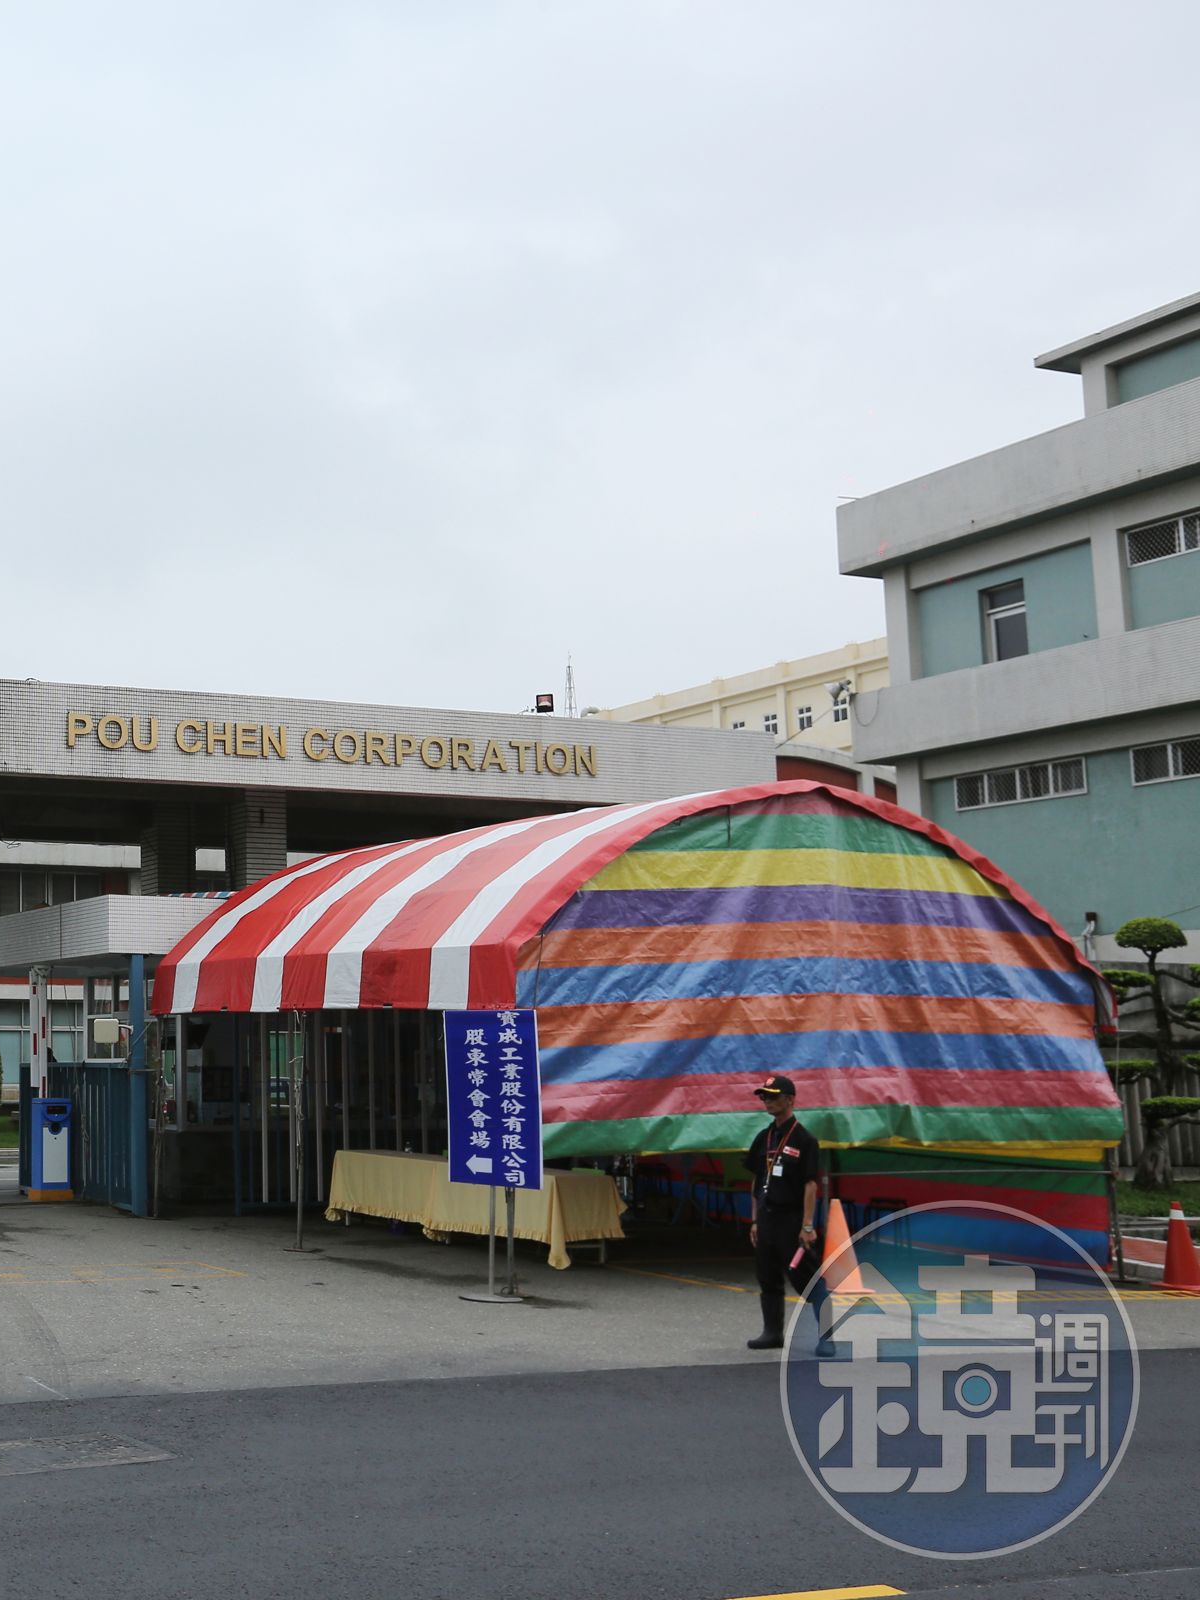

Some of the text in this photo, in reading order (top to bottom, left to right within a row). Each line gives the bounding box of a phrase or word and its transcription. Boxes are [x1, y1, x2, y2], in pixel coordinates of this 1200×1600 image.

[66, 711, 598, 777] POU CHEN CORPORATION
[464, 1028, 492, 1149] 股東常會會場
[496, 1010, 527, 1187] 寶成工業股份有限公司
